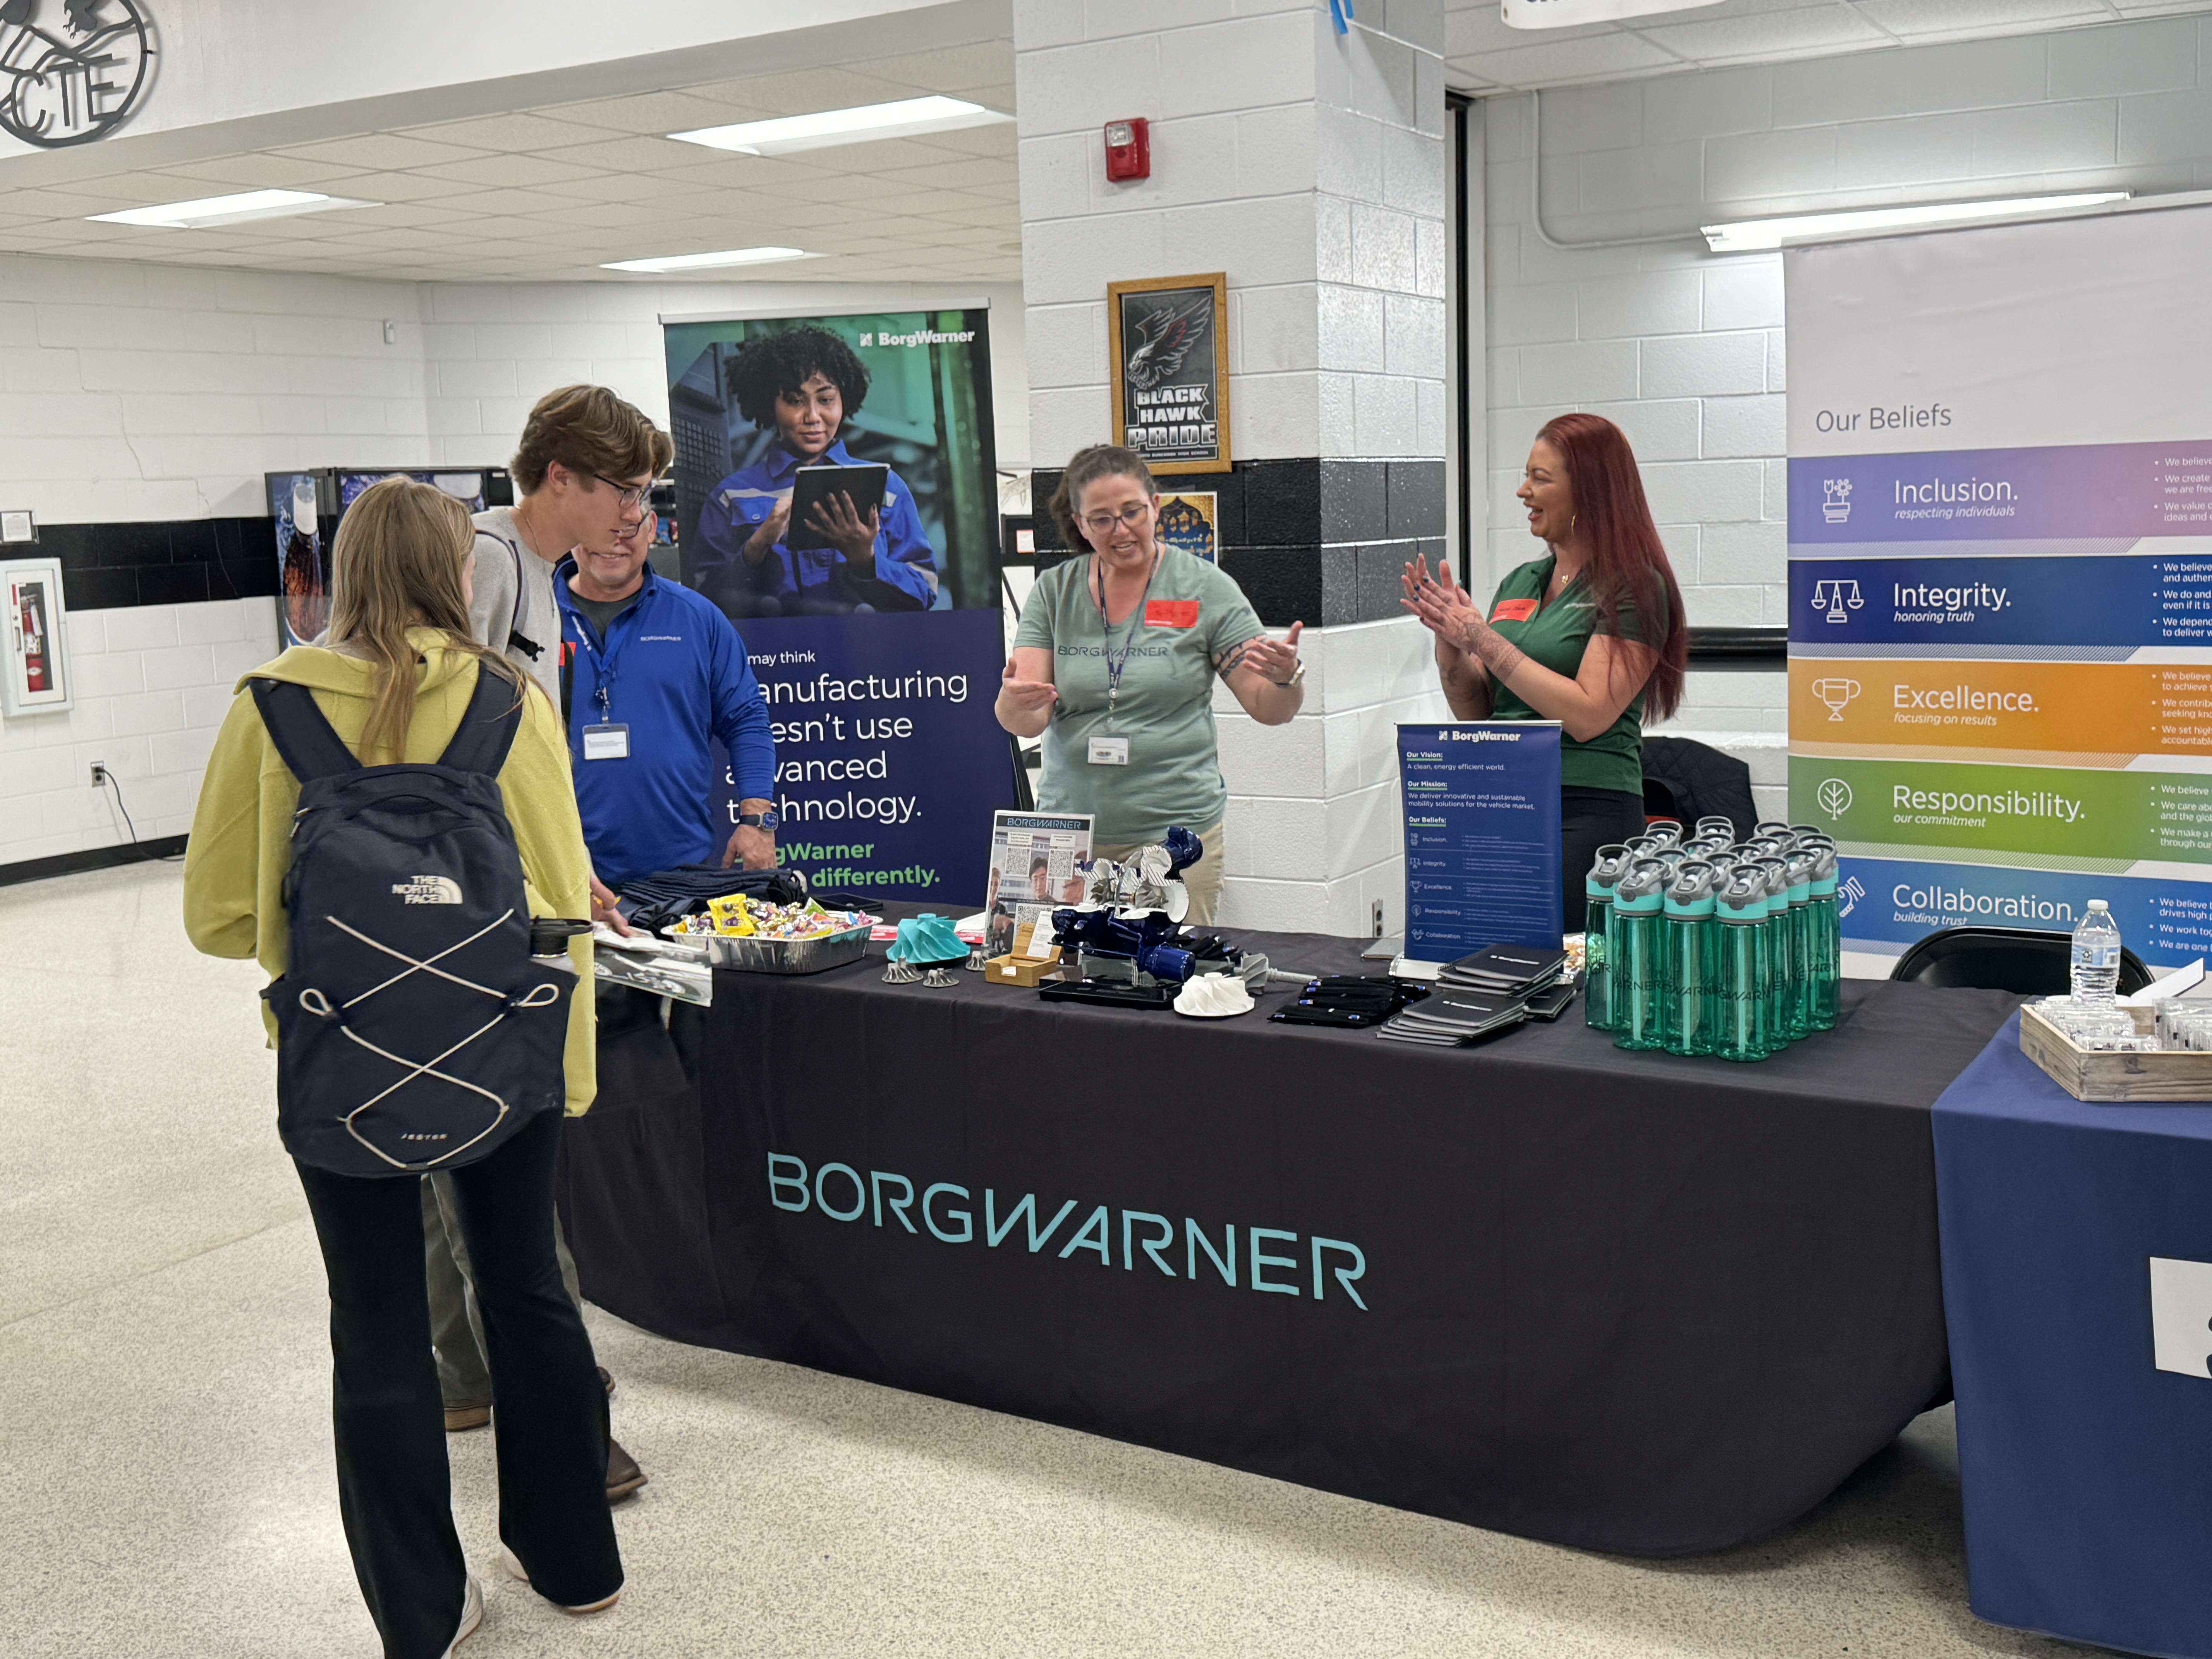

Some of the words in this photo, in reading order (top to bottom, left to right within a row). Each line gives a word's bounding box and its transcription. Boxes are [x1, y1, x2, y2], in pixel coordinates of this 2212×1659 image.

[11, 53, 120, 134] CTE
[879, 330, 975, 347] BorgWarner
[1137, 388, 1203, 405] BLACK
[1140, 406, 1201, 422] HAWK
[1816, 410, 1861, 433] Our
[1870, 404, 1951, 429] Beliefs
[1128, 424, 1216, 448] PRIDE
[2182, 474, 2210, 483] create
[1895, 478, 2018, 504] Inclusion.
[2164, 502, 2179, 510] We
[2182, 501, 2205, 510] value
[1895, 506, 1953, 521] respecting
[1955, 505, 2015, 518] individuals
[2164, 513, 2188, 521] ideas
[2190, 512, 2207, 521] and
[2163, 563, 2178, 571] We
[2163, 574, 2180, 582] and
[1894, 582, 2012, 611] Integrity.
[2163, 590, 2178, 598] We
[2180, 590, 2192, 599] do
[2194, 590, 2211, 599] and
[2187, 601, 2192, 610] if
[2195, 601, 2200, 610] it
[2203, 601, 2210, 610] is
[1894, 610, 1944, 624] honoring
[1947, 611, 1975, 622] truth
[2163, 617, 2178, 626] We
[2163, 629, 2172, 637] to
[2174, 628, 2205, 637] deliver
[747, 655, 776, 667] may
[780, 650, 816, 663] think
[2179, 672, 2210, 680] believe
[758, 670, 968, 704] anufacturing
[2174, 683, 2207, 691] achieve
[1894, 685, 2039, 712] Excellence.
[1894, 713, 1941, 725] focusing
[1944, 715, 1958, 724] on
[1961, 715, 1997, 726] results
[2162, 710, 2195, 719] seeking
[769, 713, 845, 743] esn't
[857, 716, 913, 740] use
[2162, 726, 2176, 734] We
[1452, 731, 1521, 743] BorgWarner
[2161, 785, 2175, 793] We
[2178, 786, 2209, 795] believe
[726, 791, 922, 824] thnology.
[1894, 785, 2085, 823] Responsibility.
[2161, 801, 2175, 809] We
[1894, 814, 1913, 823] our
[1915, 815, 1986, 828] commitment
[2179, 813, 2194, 821] the
[1007, 818, 1081, 829] BORGWARNER
[2160, 828, 2175, 836] We
[2177, 829, 2201, 838] make
[2160, 838, 2195, 849] through
[410, 876, 438, 884] THE
[812, 865, 940, 888] differently.
[392, 884, 436, 894] NORTH
[405, 894, 438, 904] FACE
[1893, 884, 2079, 922] Collaboration.
[2160, 898, 2174, 907] We
[2176, 899, 2207, 909] believe
[1894, 911, 1939, 926] building
[1941, 915, 1967, 926] trust
[2159, 908, 2186, 918] drives
[2188, 910, 2207, 921] high
[2160, 924, 2174, 933] We
[2176, 926, 2197, 935] work
[2159, 939, 2173, 948] We
[2191, 944, 2208, 952] one
[768, 1151, 1369, 1311] BORGWARNER
